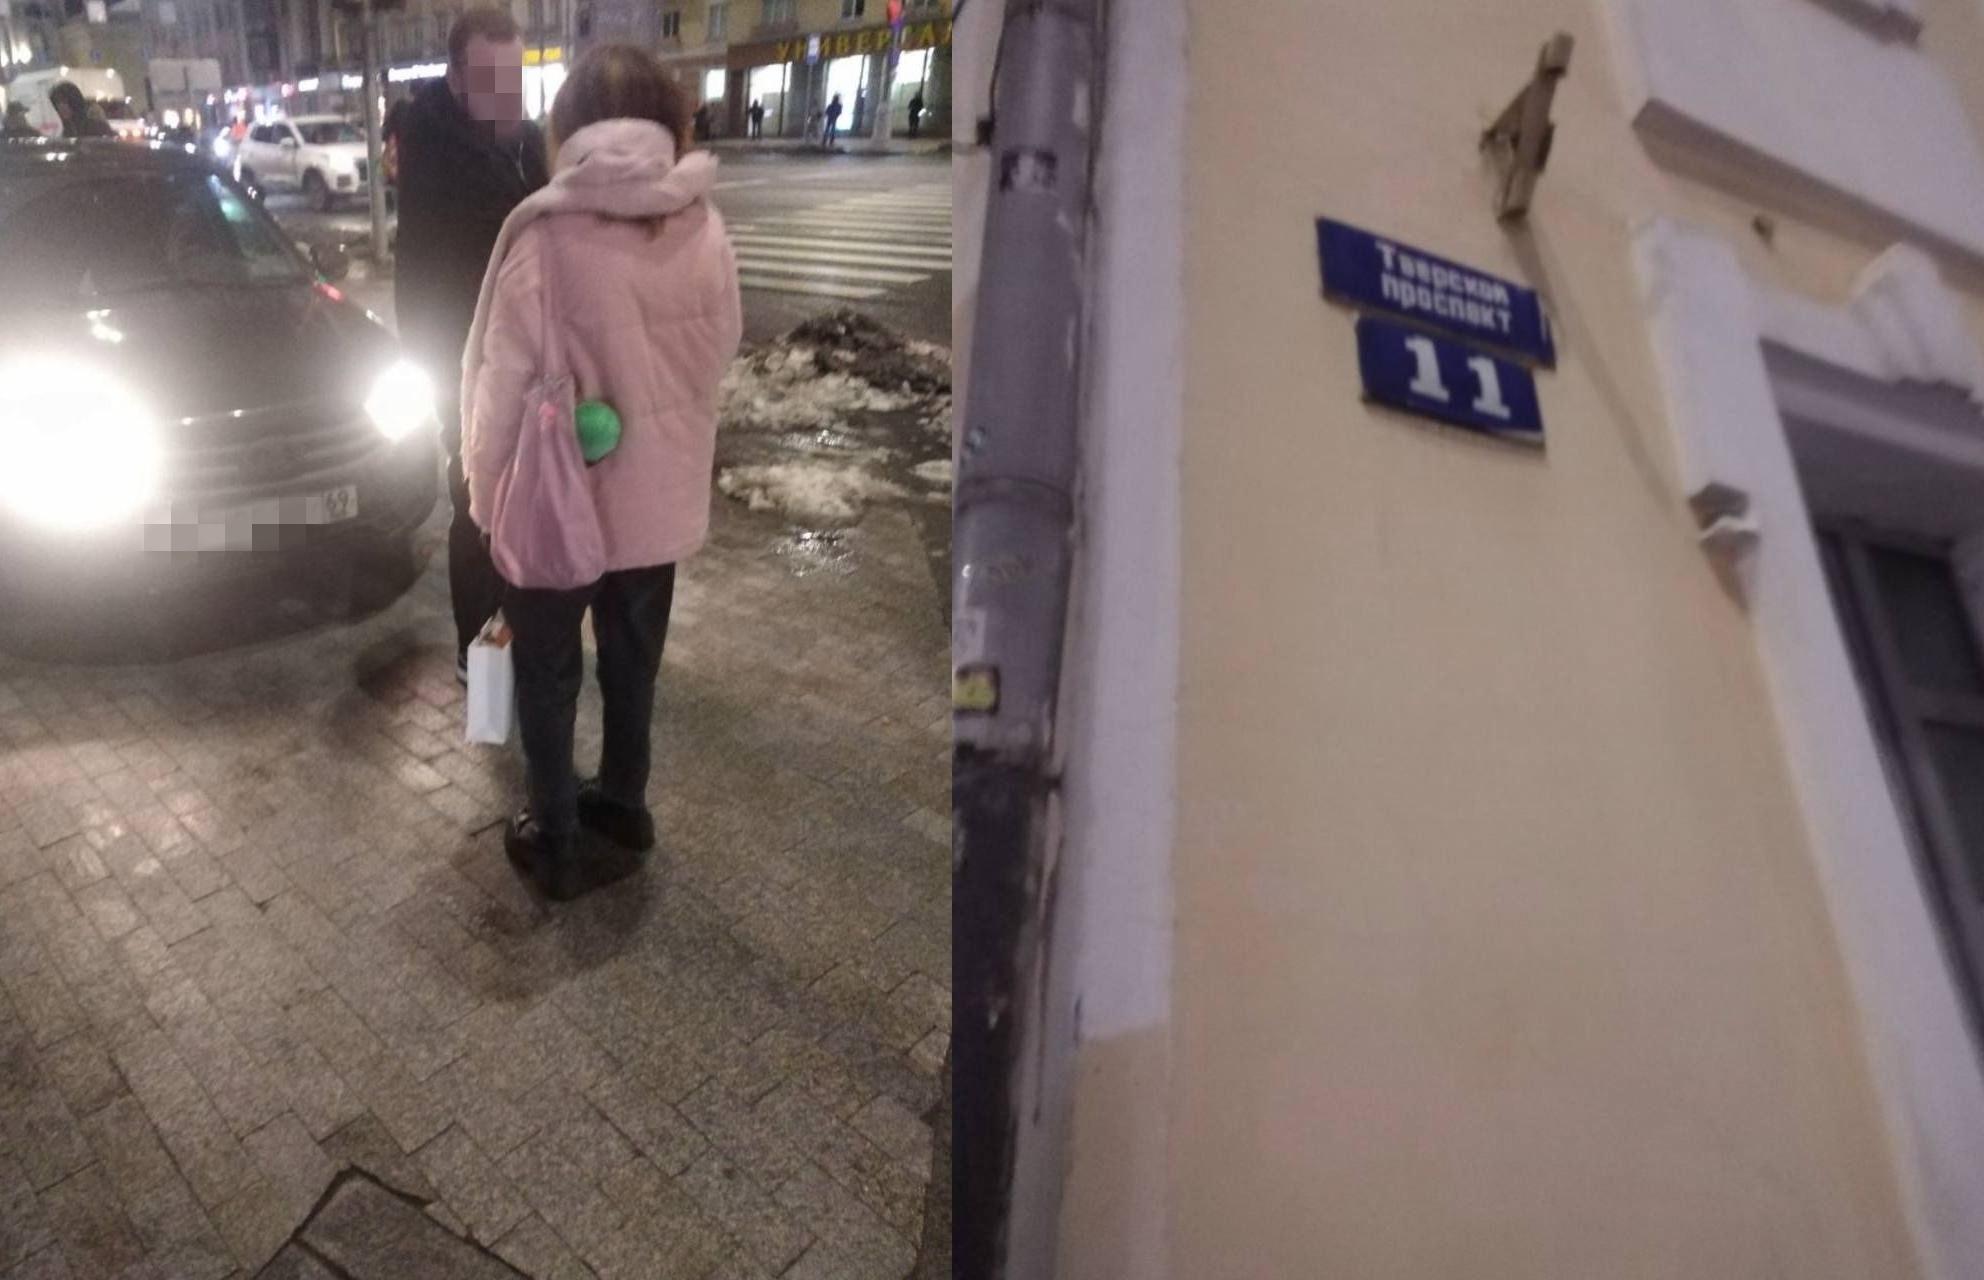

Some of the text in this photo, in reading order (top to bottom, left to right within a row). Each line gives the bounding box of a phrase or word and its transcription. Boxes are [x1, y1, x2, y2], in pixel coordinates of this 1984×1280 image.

[776, 20, 951, 62] УНИВЕРА
[1381, 272, 1513, 334] проспект
[1404, 334, 1511, 419] 11
